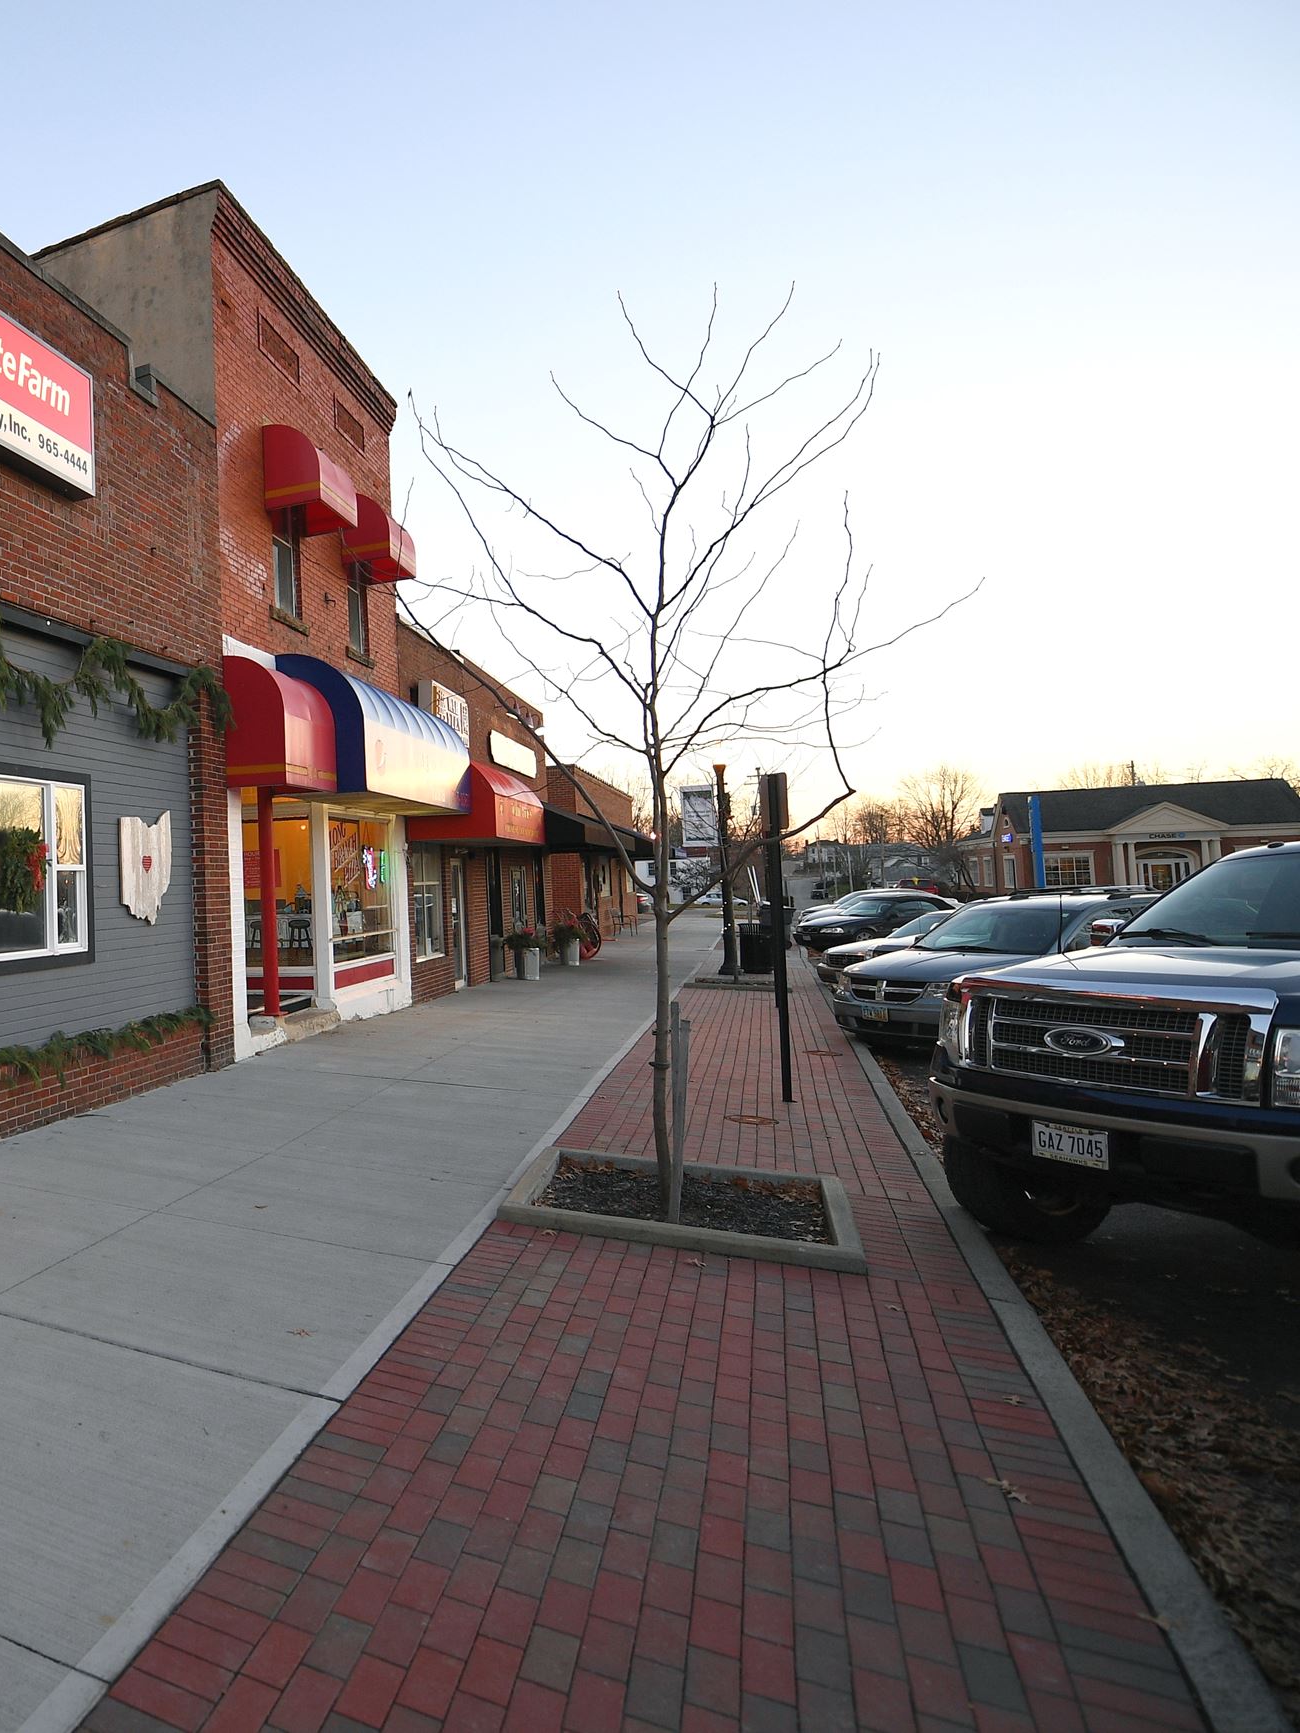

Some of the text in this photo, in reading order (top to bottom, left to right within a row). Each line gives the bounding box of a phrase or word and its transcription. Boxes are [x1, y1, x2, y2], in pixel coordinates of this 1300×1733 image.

[38, 433, 88, 475] 965-4444
[1148, 831, 1177, 839] CHASE
[1061, 1032, 1092, 1047] Ford
[1038, 1130, 1103, 1159] GAZ 7045
[1050, 1153, 1088, 1166] SEAHAWKS
